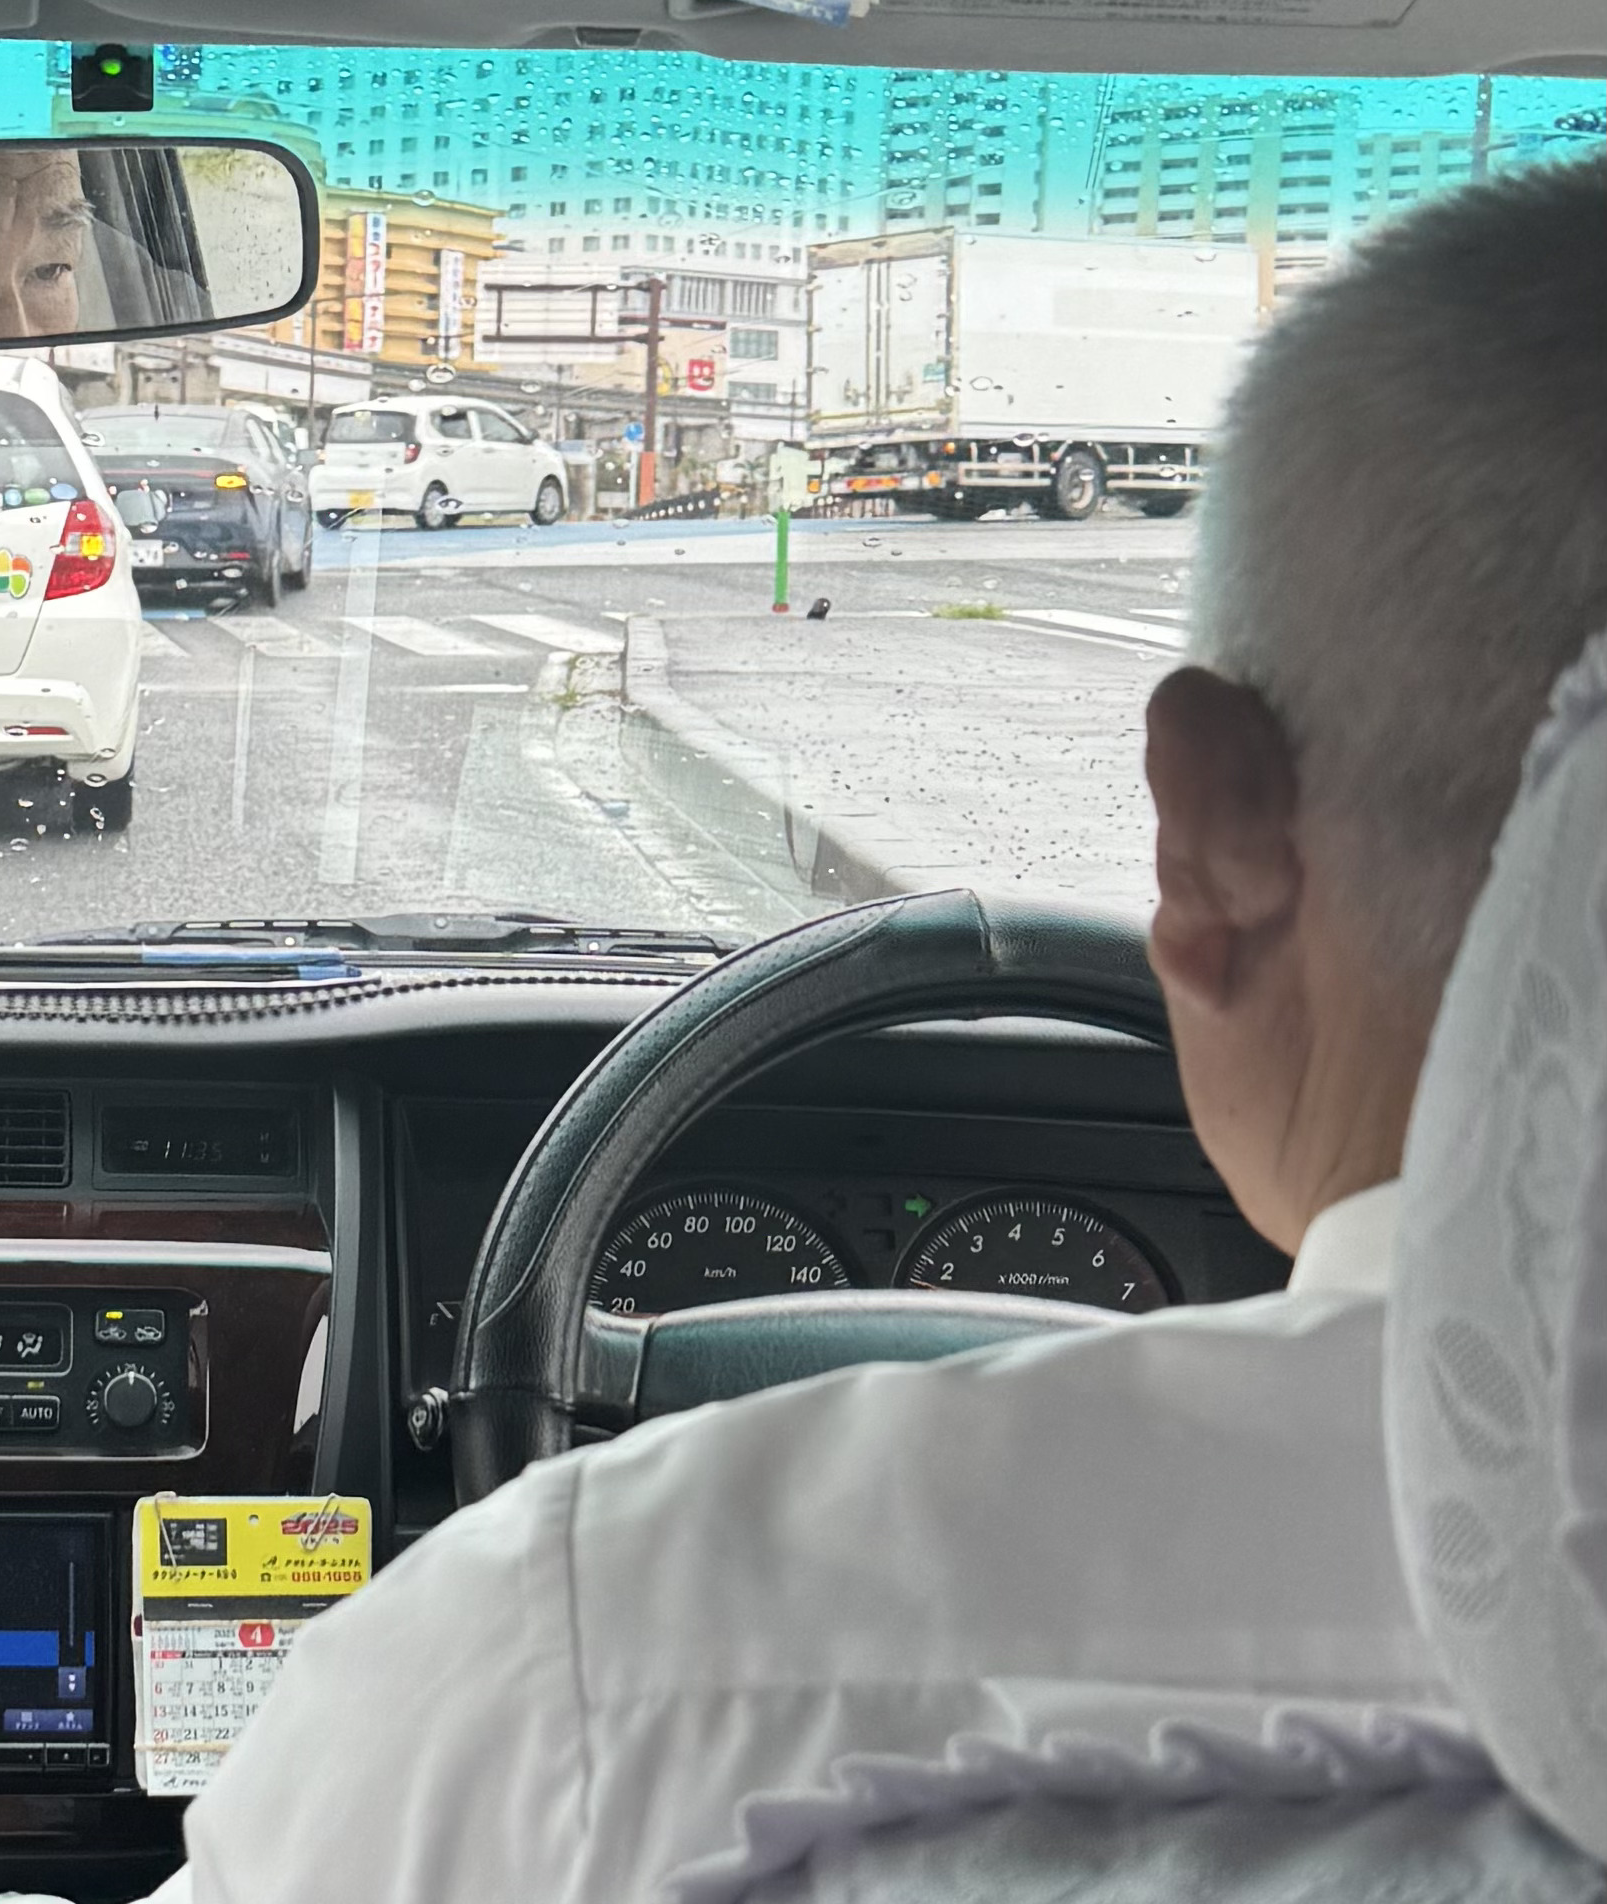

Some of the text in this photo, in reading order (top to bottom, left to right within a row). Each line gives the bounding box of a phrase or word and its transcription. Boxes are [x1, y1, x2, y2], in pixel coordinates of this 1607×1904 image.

[683, 1216, 756, 1233] 80 100
[647, 1232, 796, 1252] 60 120
[1007, 1223, 1066, 1246] 4 5
[970, 1235, 1105, 1267] 3 6
[619, 1260, 821, 1283] 40 140
[940, 1262, 1135, 1300] 2 7
[610, 1297, 635, 1313] 20
[20, 1407, 53, 1419] AUTO
[249, 1625, 263, 1645] 4
[245, 1659, 254, 1670] 2
[154, 1681, 255, 1695] 6 7 8 9
[184, 1705, 197, 1717] 14
[215, 1704, 229, 1717] 15
[183, 1728, 198, 1741] 21
[215, 1728, 230, 1740] 22
